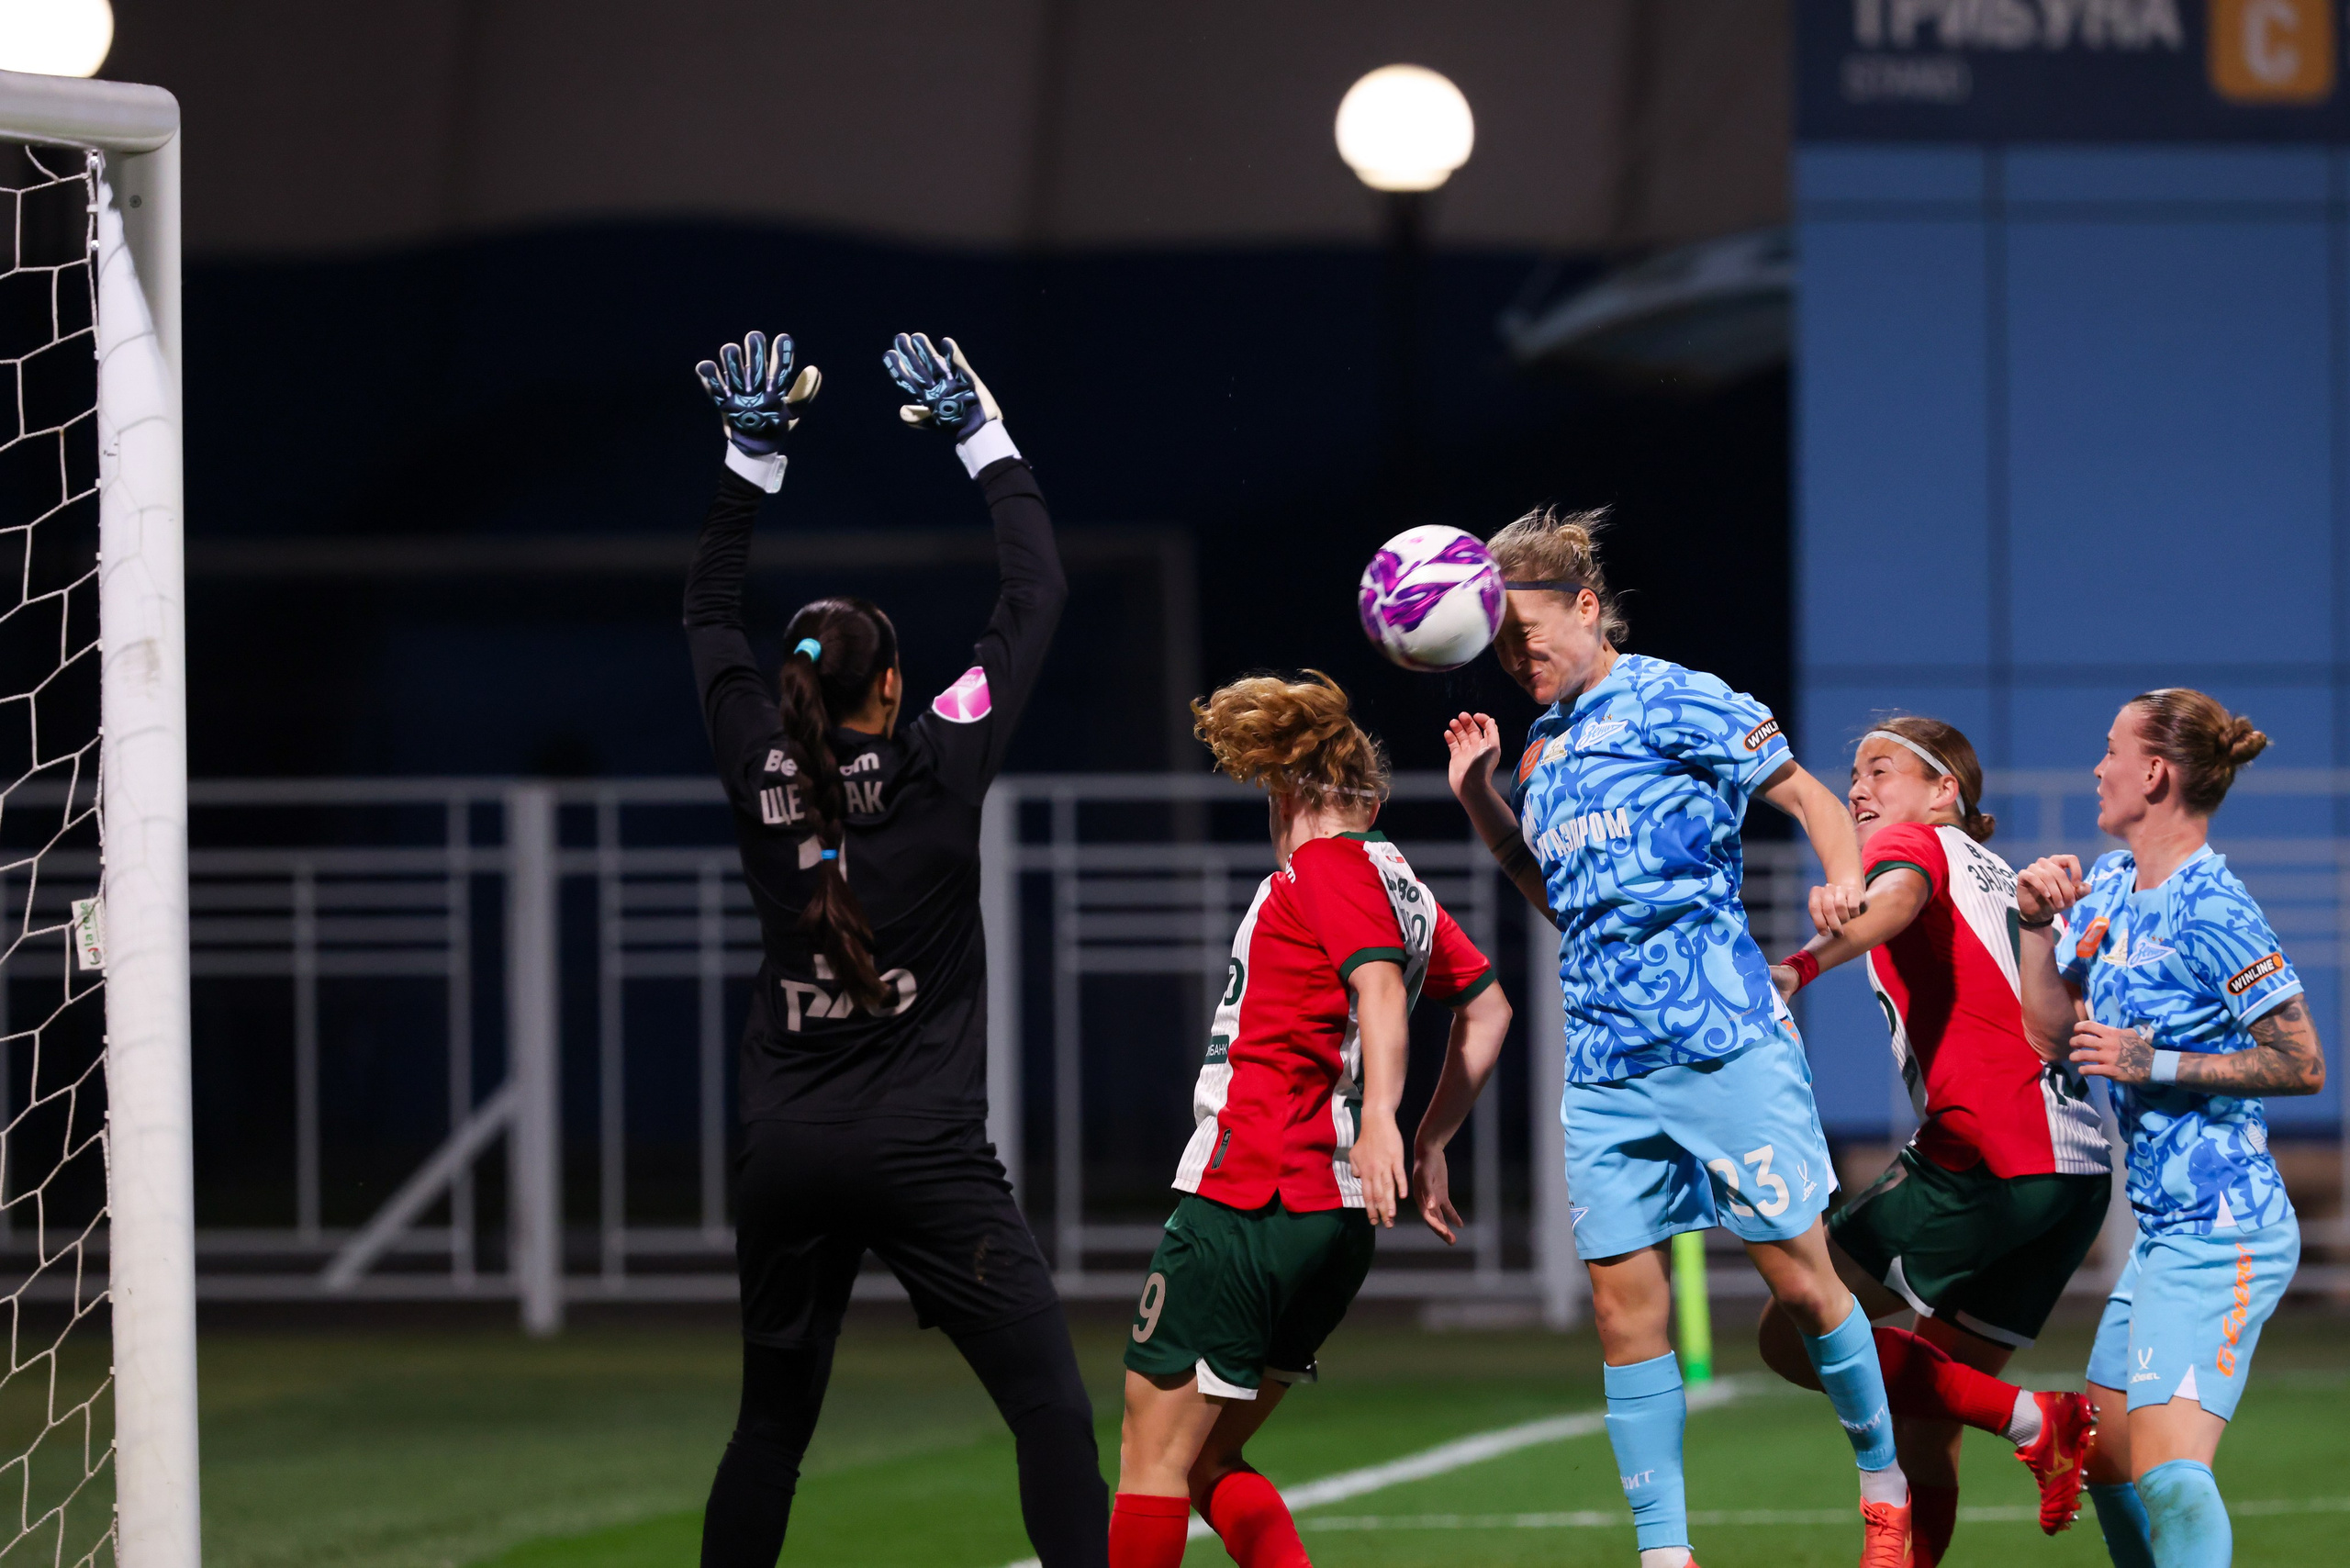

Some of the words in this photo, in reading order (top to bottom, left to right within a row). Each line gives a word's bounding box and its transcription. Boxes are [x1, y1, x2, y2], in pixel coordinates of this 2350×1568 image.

[760, 781, 886, 825] ЩЕАК
[2231, 958, 2276, 992] WINLINE
[1707, 1144, 1790, 1217] 23
[1132, 1271, 1166, 1343] 9
